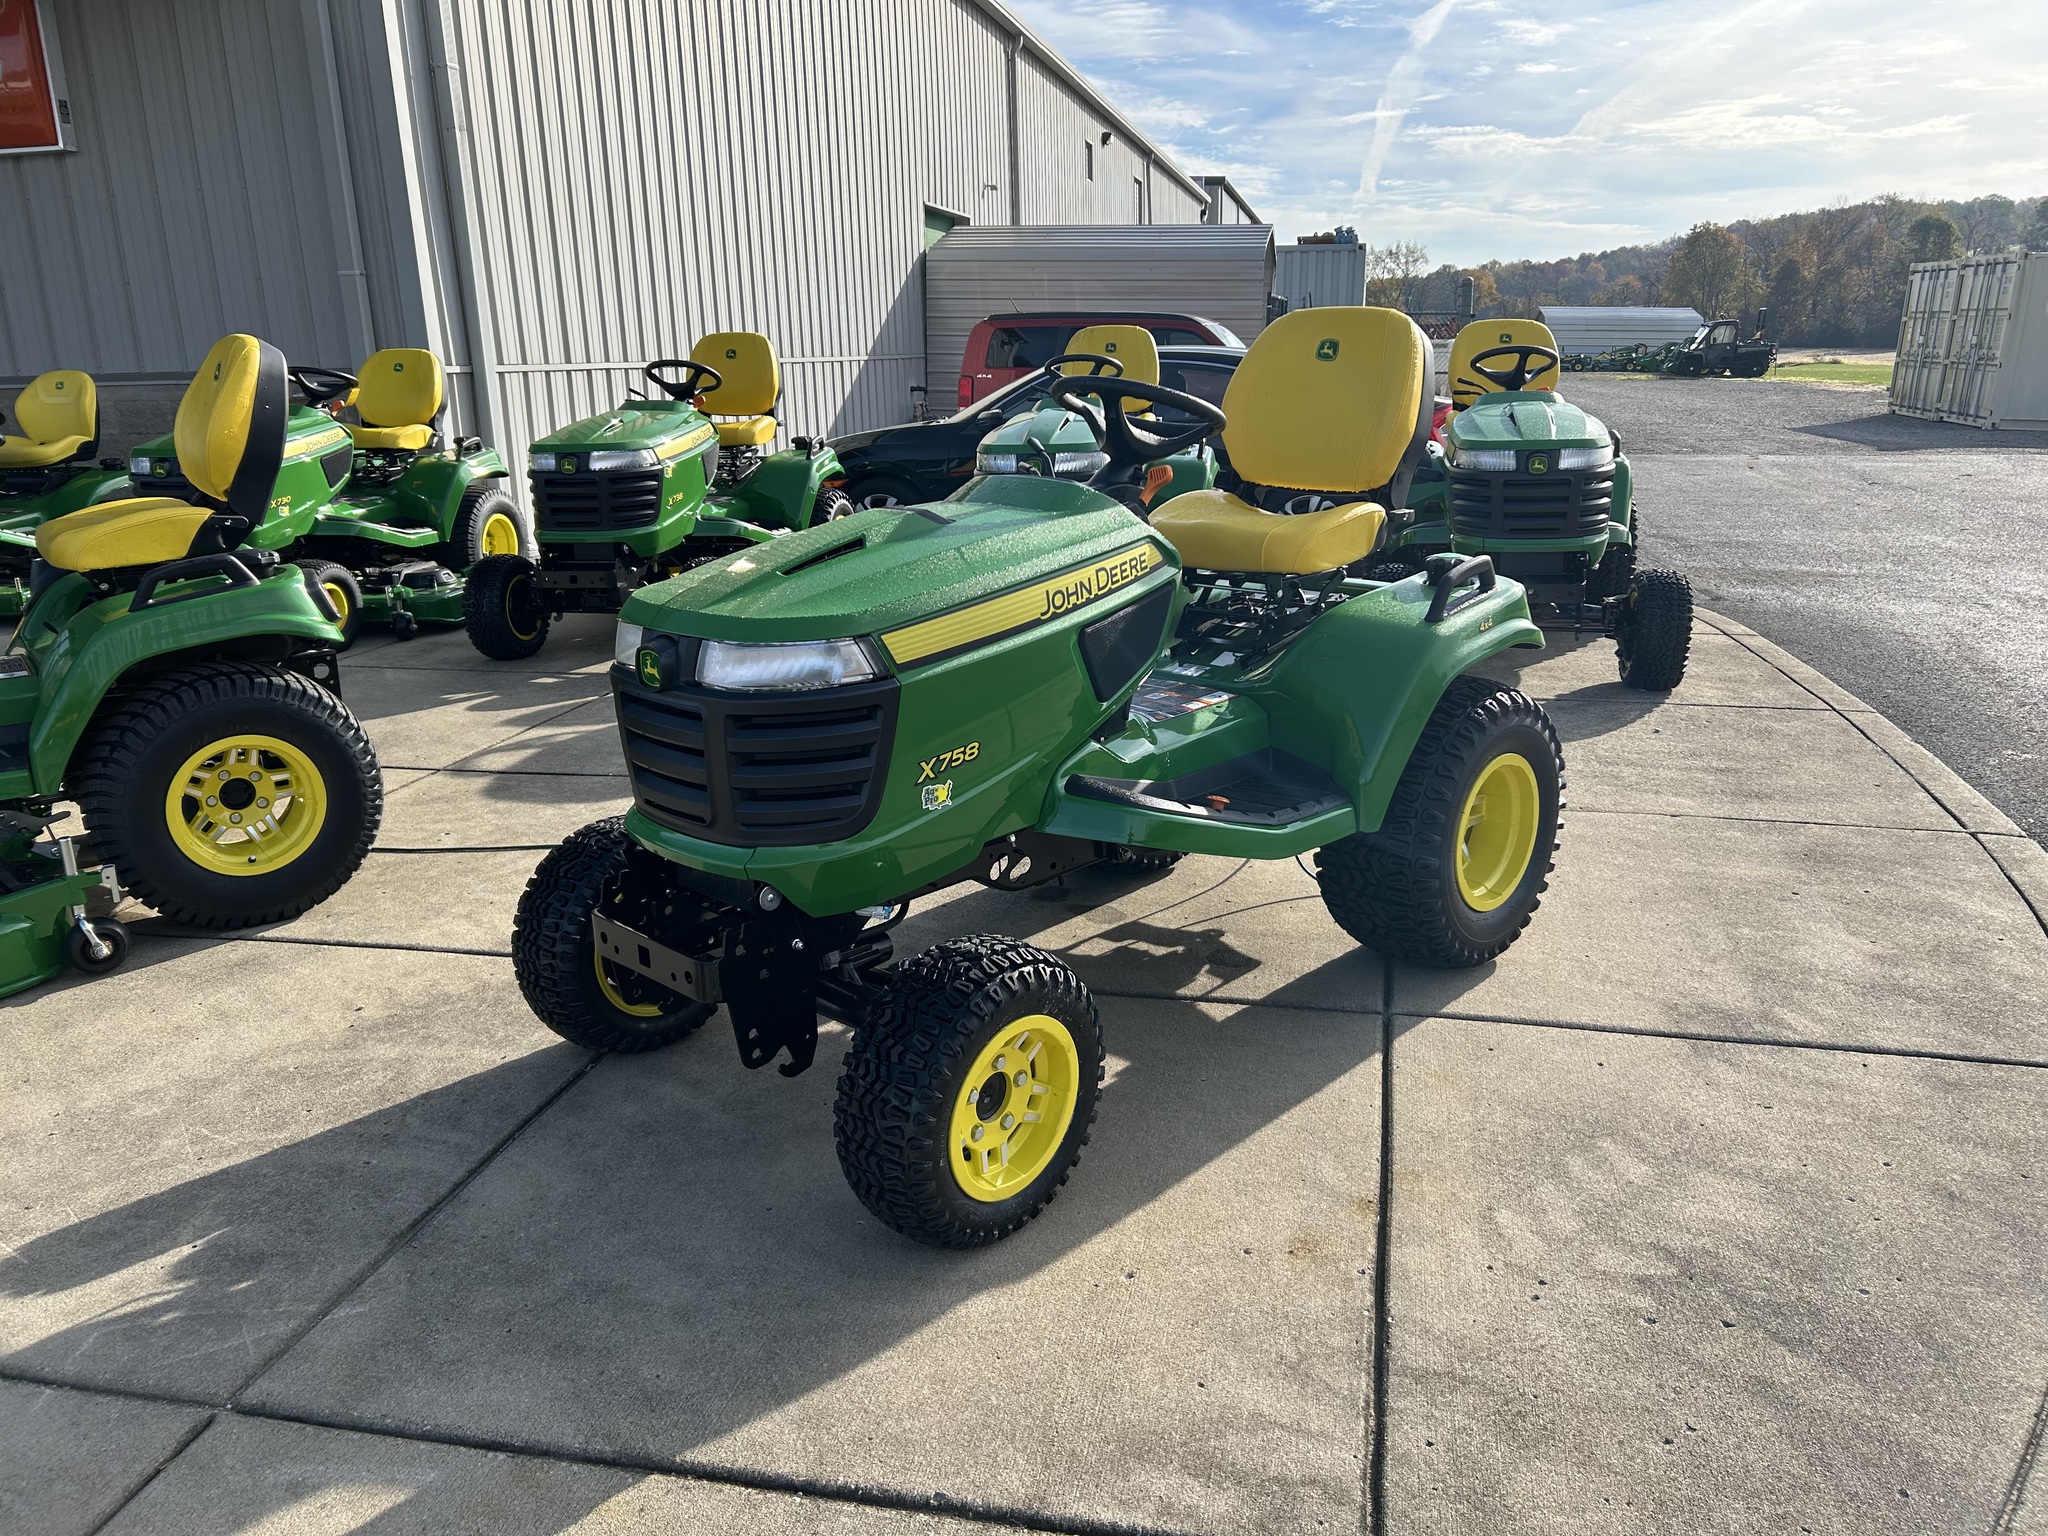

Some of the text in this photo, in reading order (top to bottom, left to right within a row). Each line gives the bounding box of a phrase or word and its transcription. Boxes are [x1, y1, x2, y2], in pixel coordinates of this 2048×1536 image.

[305, 431, 341, 452] JOHN DEERE
[270, 496, 292, 509] X730
[1040, 551, 1149, 618] JOHN DEERE
[915, 741, 981, 785] X758
